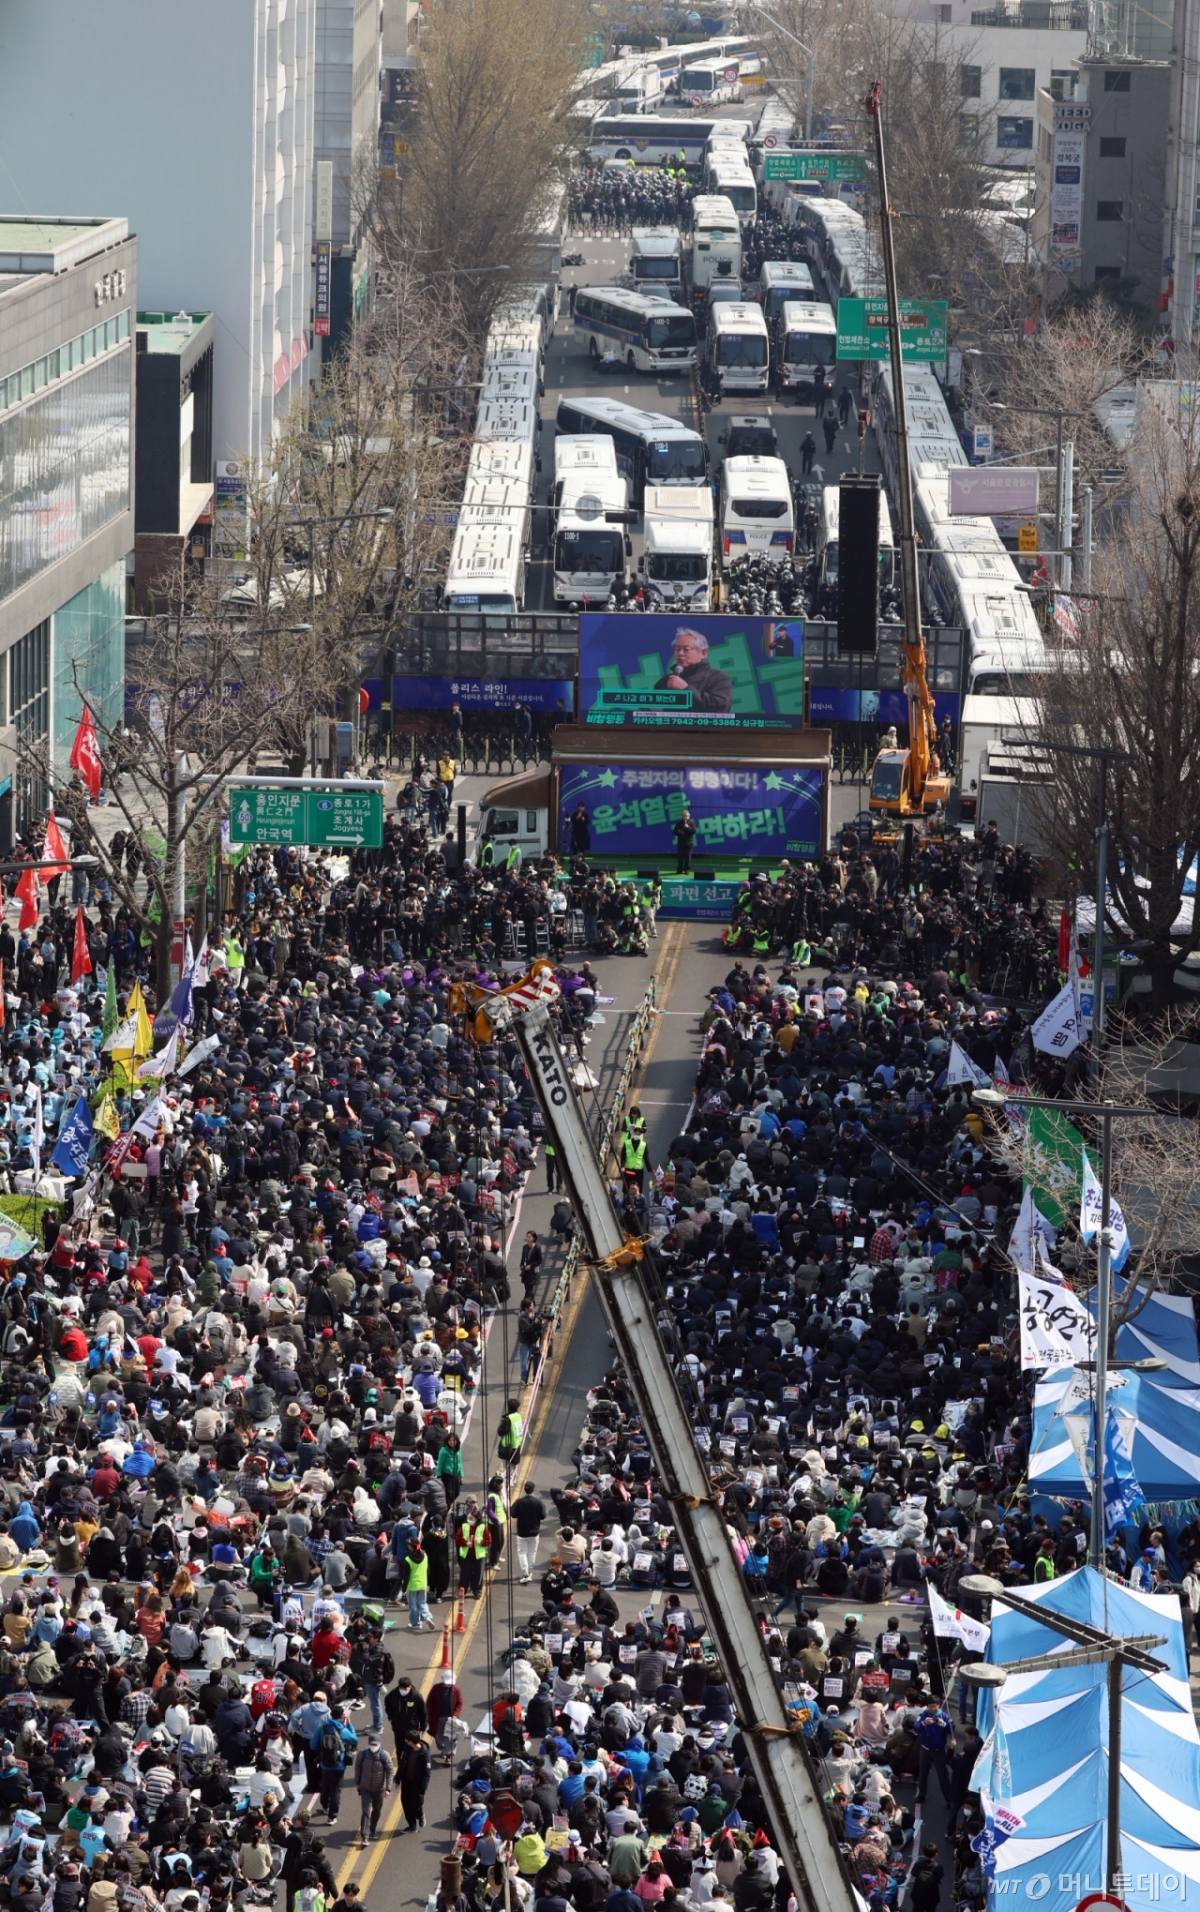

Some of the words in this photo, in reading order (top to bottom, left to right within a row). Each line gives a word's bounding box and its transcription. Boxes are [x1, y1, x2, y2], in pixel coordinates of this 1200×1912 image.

[1054, 107, 1091, 118] NEED
[1054, 121, 1091, 131] YOGA
[839, 336, 870, 344] 헌법재판소
[450, 683, 480, 694] 폴리스
[484, 684, 508, 695] 라인!
[633, 717, 670, 725] 카카오뱅크
[672, 717, 741, 727] 7942-09-53862
[622, 771, 683, 788] 주권자의
[689, 771, 758, 789] 명령이다!
[256, 794, 301, 807] 흥인지문
[322, 801, 328, 809] 6
[239, 813, 249, 821] 50
[592, 791, 692, 834] 윤석열을
[333, 816, 363, 825] 조계사
[256, 828, 292, 840] 안국역
[669, 885, 699, 901] 파면
[703, 886, 733, 901] 선고
[532, 1032, 567, 1106] KATO
[256, 1692, 271, 1704] 47
[996, 1809, 1021, 1826] HEALTH
[1000, 1820, 1014, 1832] ALL
